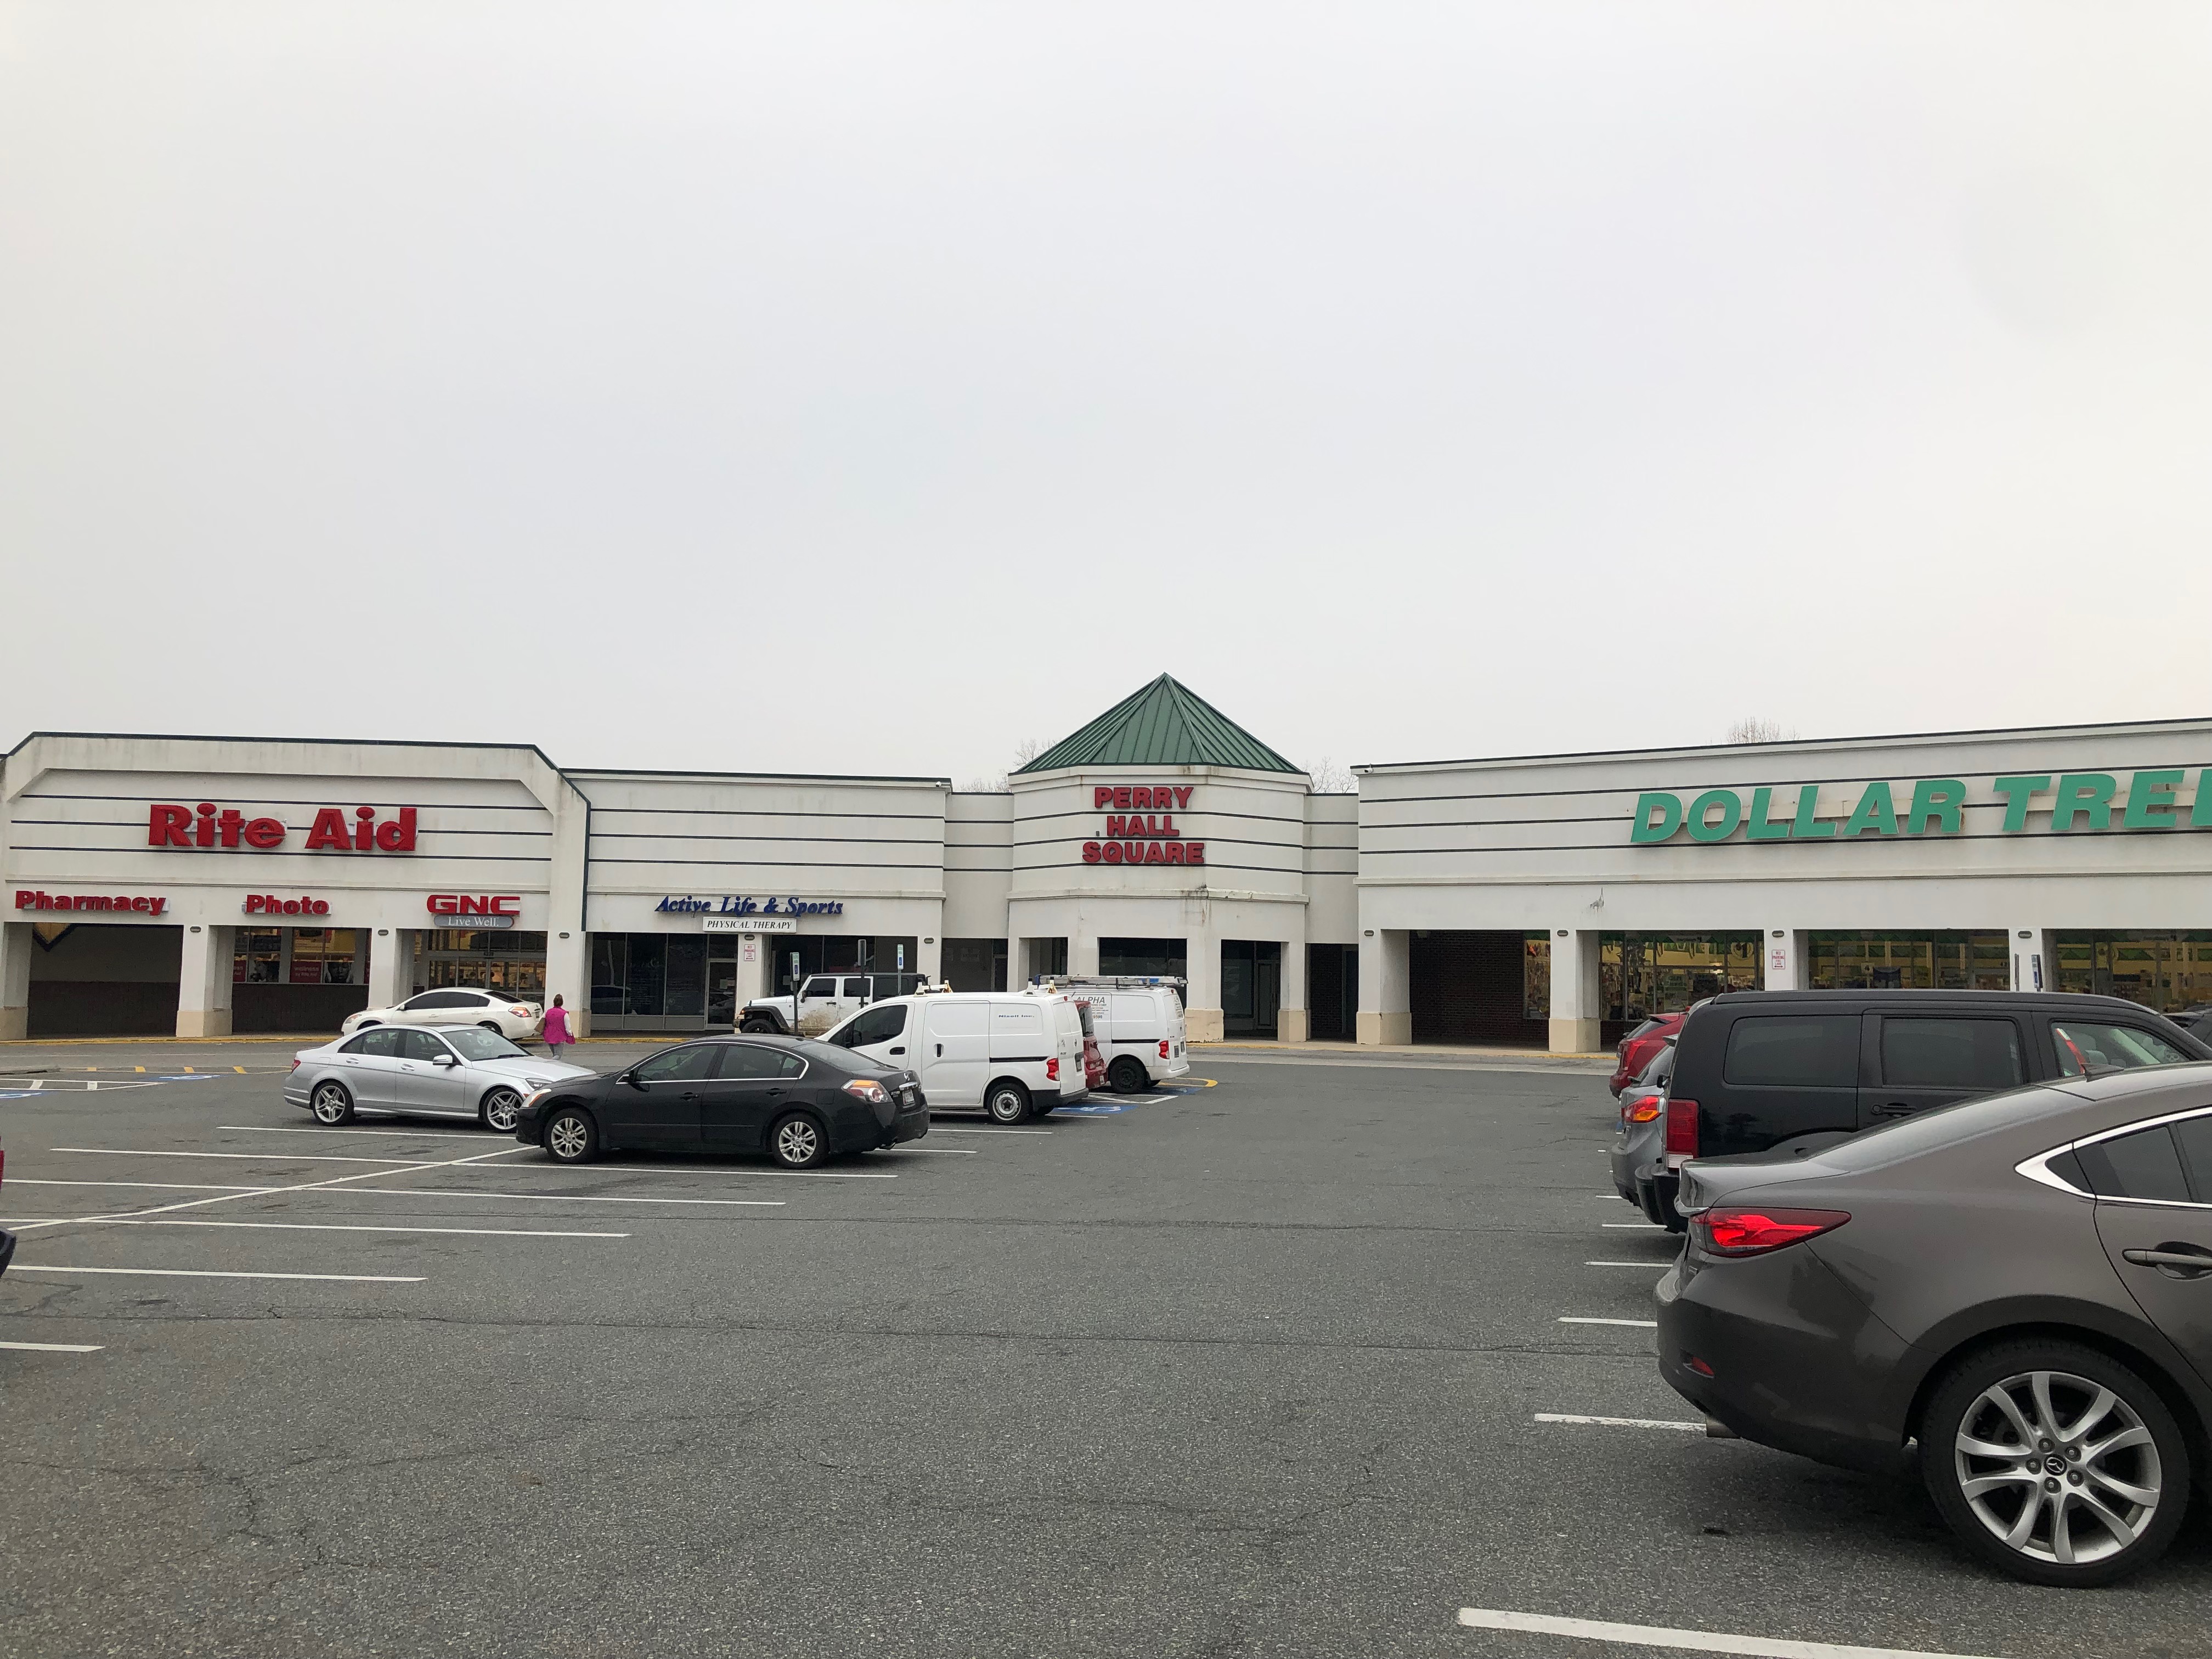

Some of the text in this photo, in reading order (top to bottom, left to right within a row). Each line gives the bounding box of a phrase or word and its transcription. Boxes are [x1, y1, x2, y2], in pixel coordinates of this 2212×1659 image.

[1094, 787, 1193, 808] PERRY
[1631, 780, 1966, 843] DOLLAR
[148, 803, 417, 851] Rite Aid
[1107, 815, 1180, 837] HALL
[1082, 841, 1205, 865] SQUARE
[15, 890, 167, 916] Pharmacy
[246, 894, 330, 915] Photo
[427, 895, 521, 915] GNC
[654, 895, 843, 917] Active Life & Sports
[448, 916, 471, 926] Live
[707, 920, 793, 929] PHYSICAL THERAPY
